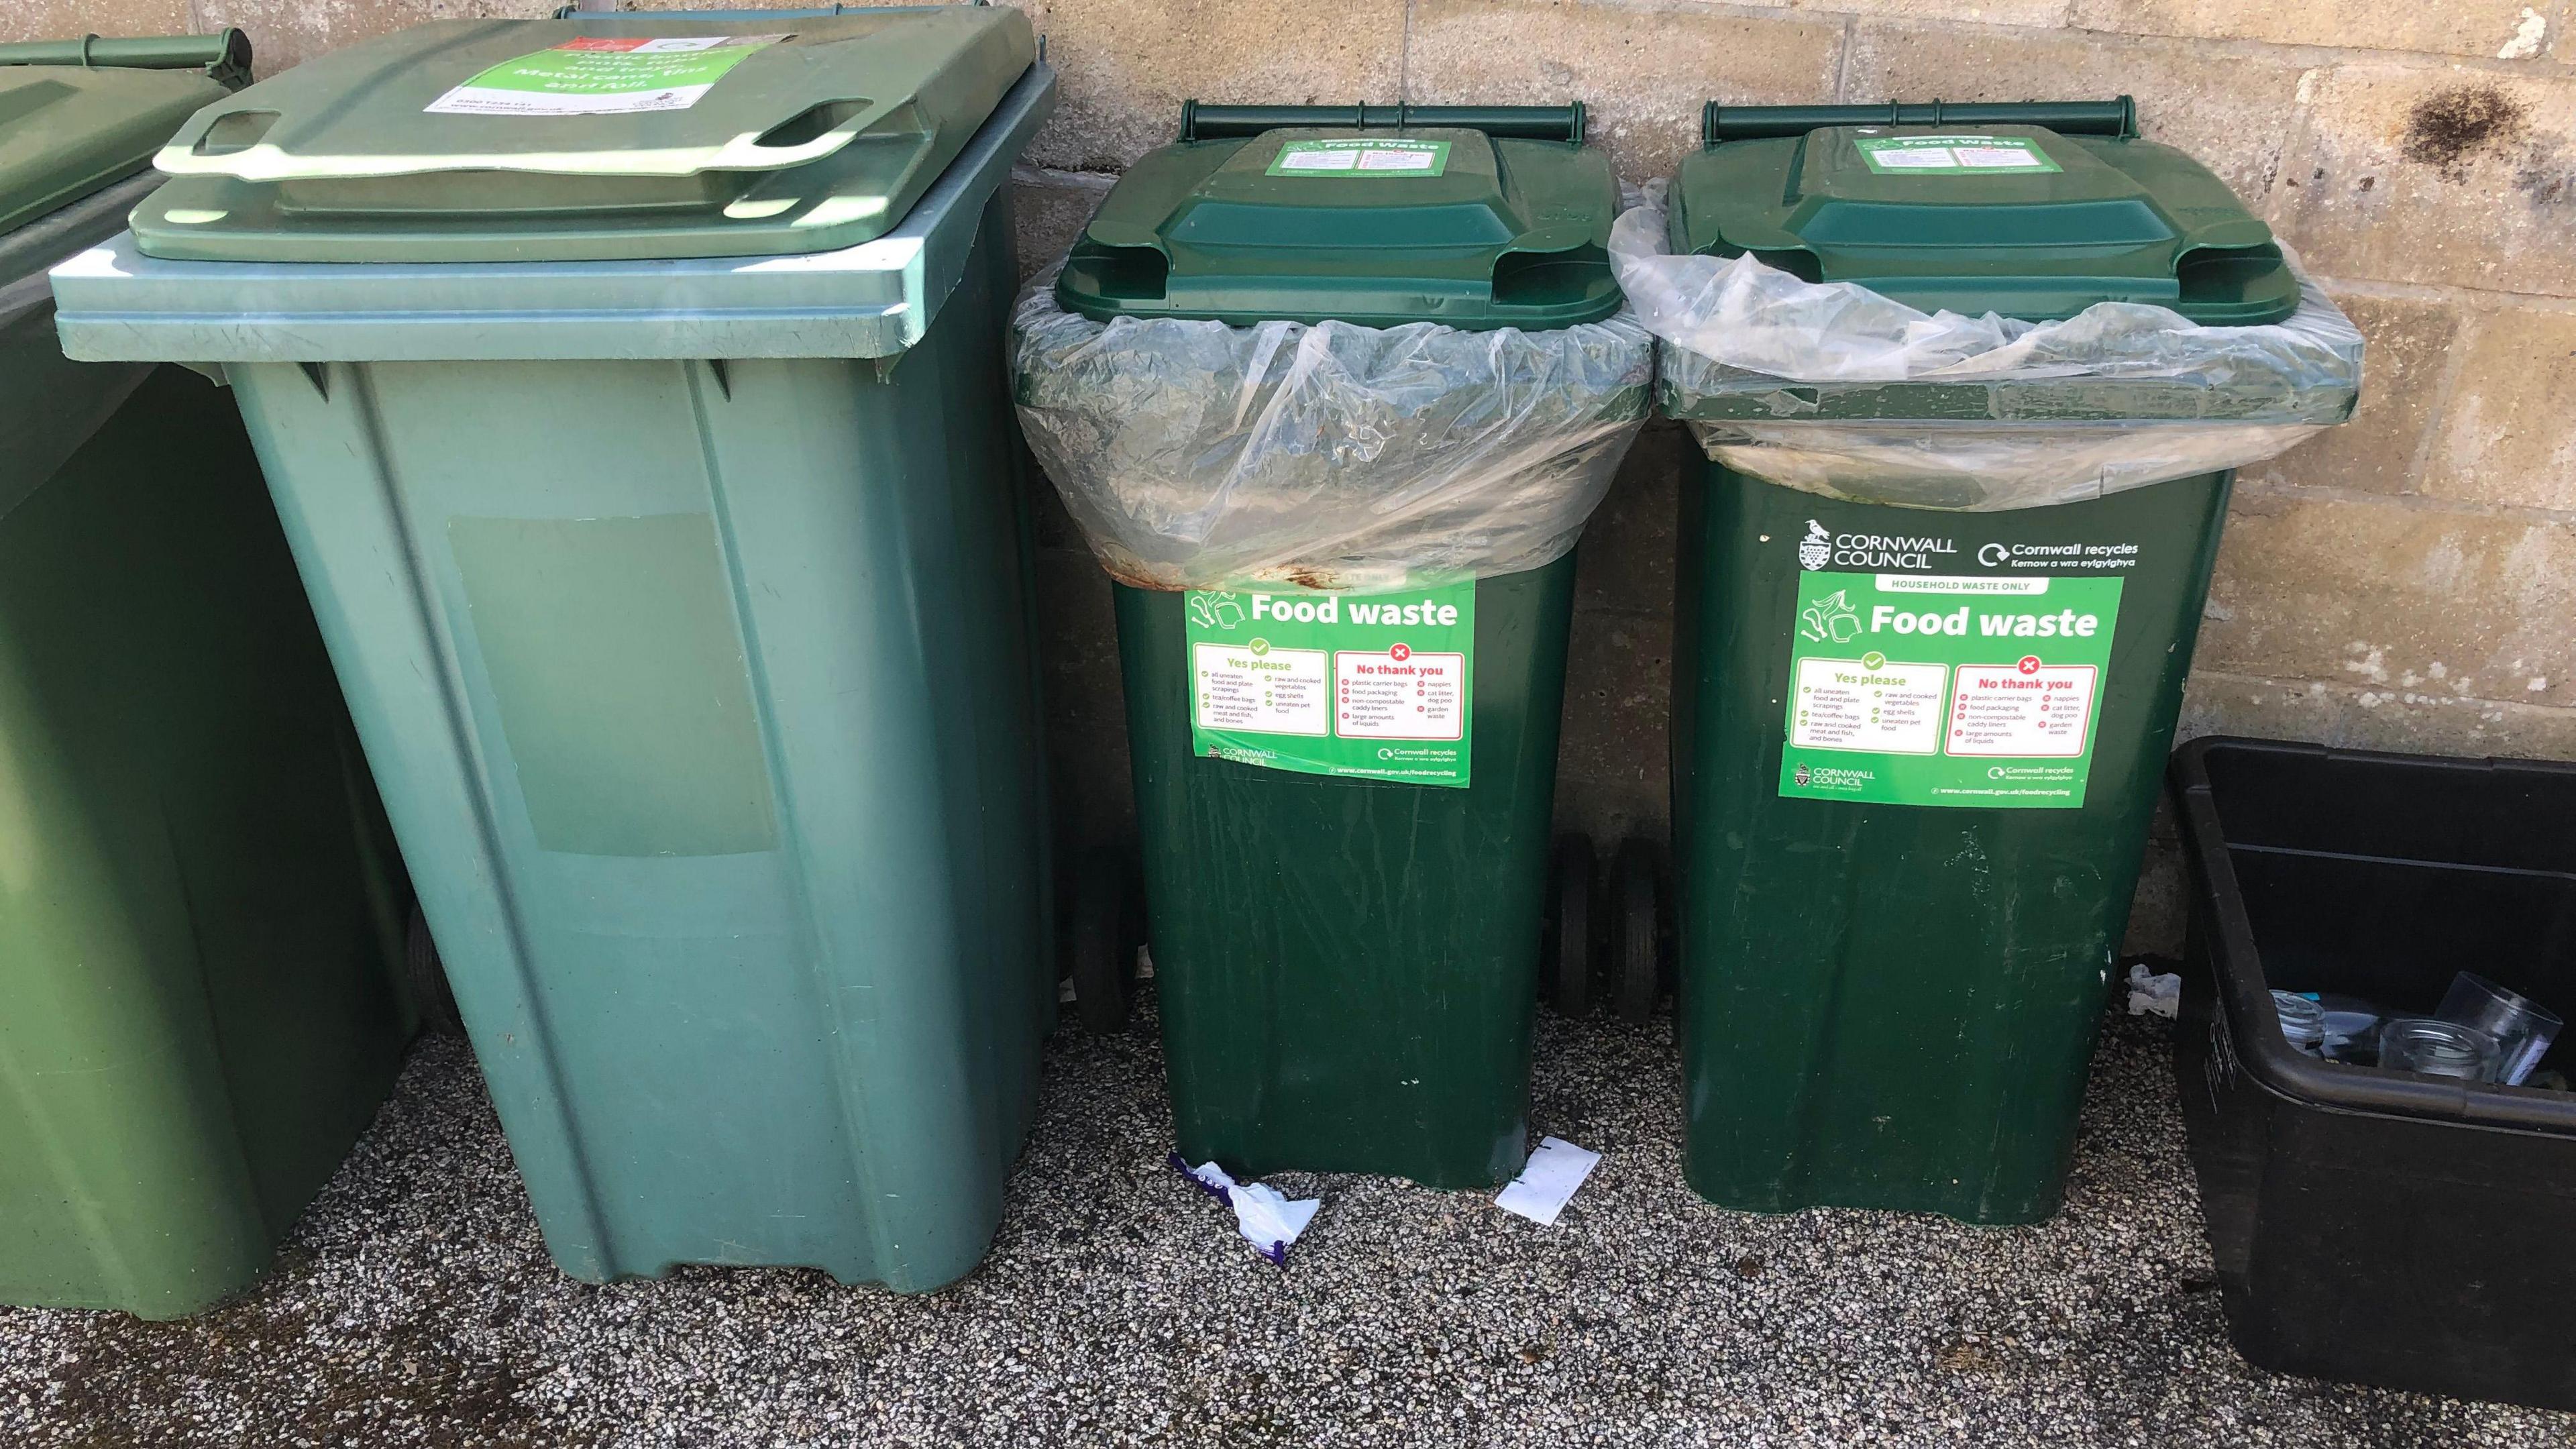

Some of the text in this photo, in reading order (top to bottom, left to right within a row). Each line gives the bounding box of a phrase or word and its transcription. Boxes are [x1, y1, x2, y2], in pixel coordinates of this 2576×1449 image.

[514, 69, 589, 79] Metal
[663, 66, 707, 76] tins
[1835, 534, 1957, 553] CORNWALL
[2012, 543, 2138, 557] Cornwall recycles
[1834, 550, 1932, 569] COUNCIL
[1892, 580, 2031, 590] HOUSEHOLD WASTE ONLY
[1252, 594, 1458, 626] Food waste
[1870, 605, 2098, 637] Food waste
[1227, 658, 1291, 671] Yes please
[1357, 665, 1443, 678] No thank you
[1835, 673, 1906, 686] Yes please
[1978, 678, 2073, 692] No thank you
[1223, 748, 1277, 759] CORNWALL
[1337, 767, 1456, 777] www.cornwall.gov.uk/foodrecycling
[1814, 768, 1876, 779] CORNWALL
[1813, 776, 1862, 786] COUNCIL
